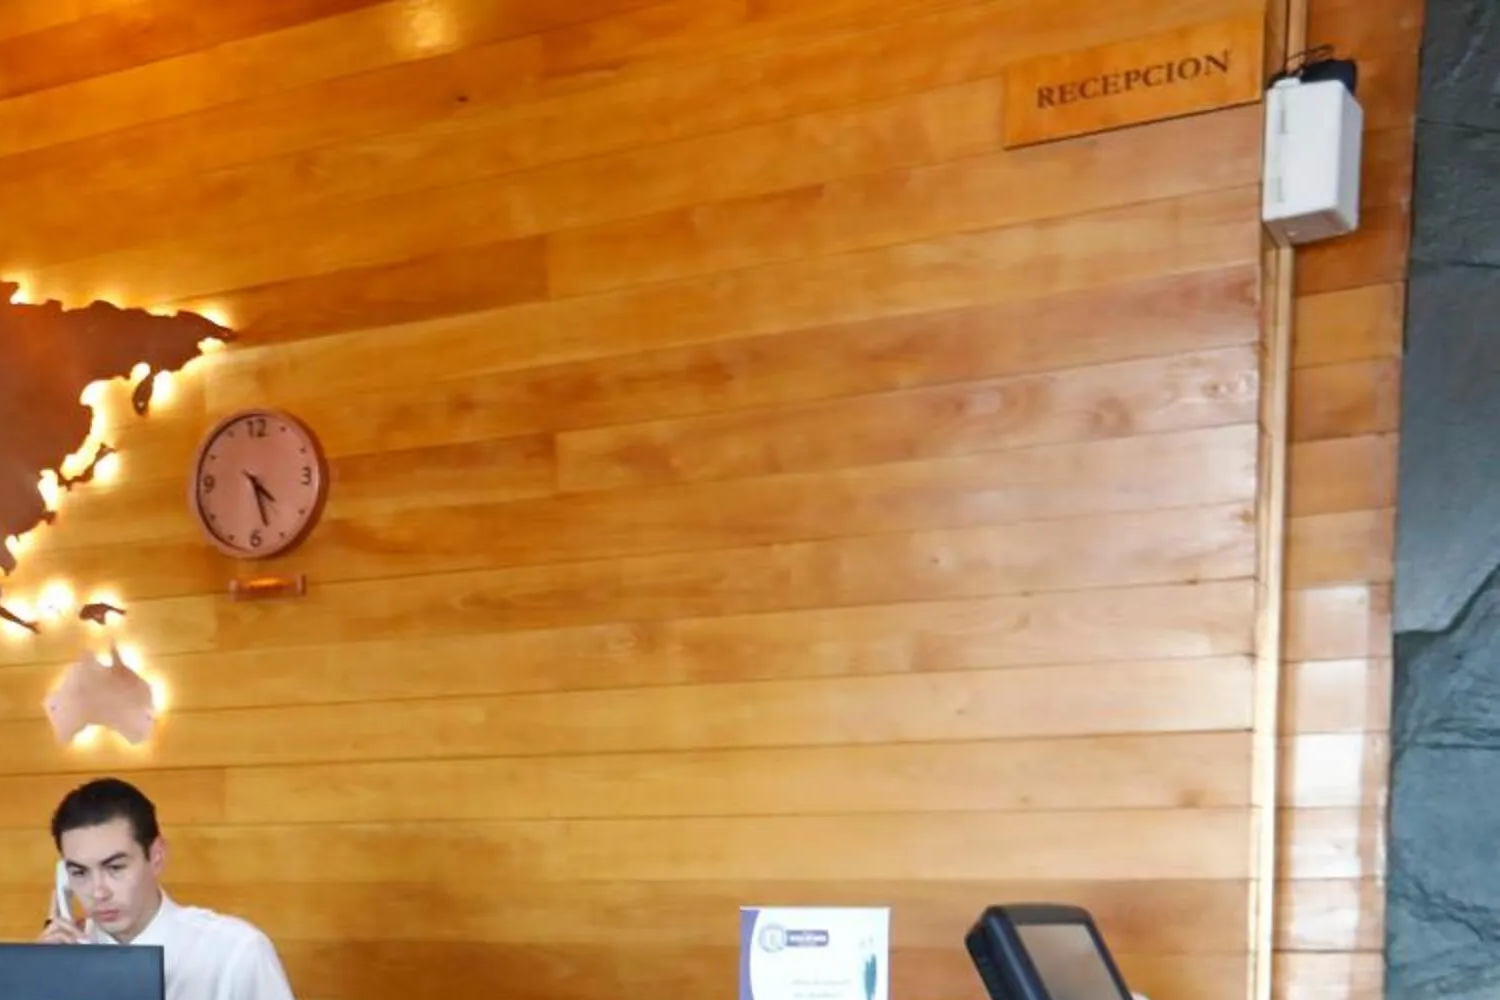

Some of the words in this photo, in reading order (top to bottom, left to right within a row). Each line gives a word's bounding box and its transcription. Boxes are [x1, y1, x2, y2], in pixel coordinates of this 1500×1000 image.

[1036, 49, 1230, 109] RECEPCION
[246, 418, 267, 437] 12
[203, 475, 215, 493] 9
[301, 466, 312, 485] 3
[250, 530, 261, 547] 6
